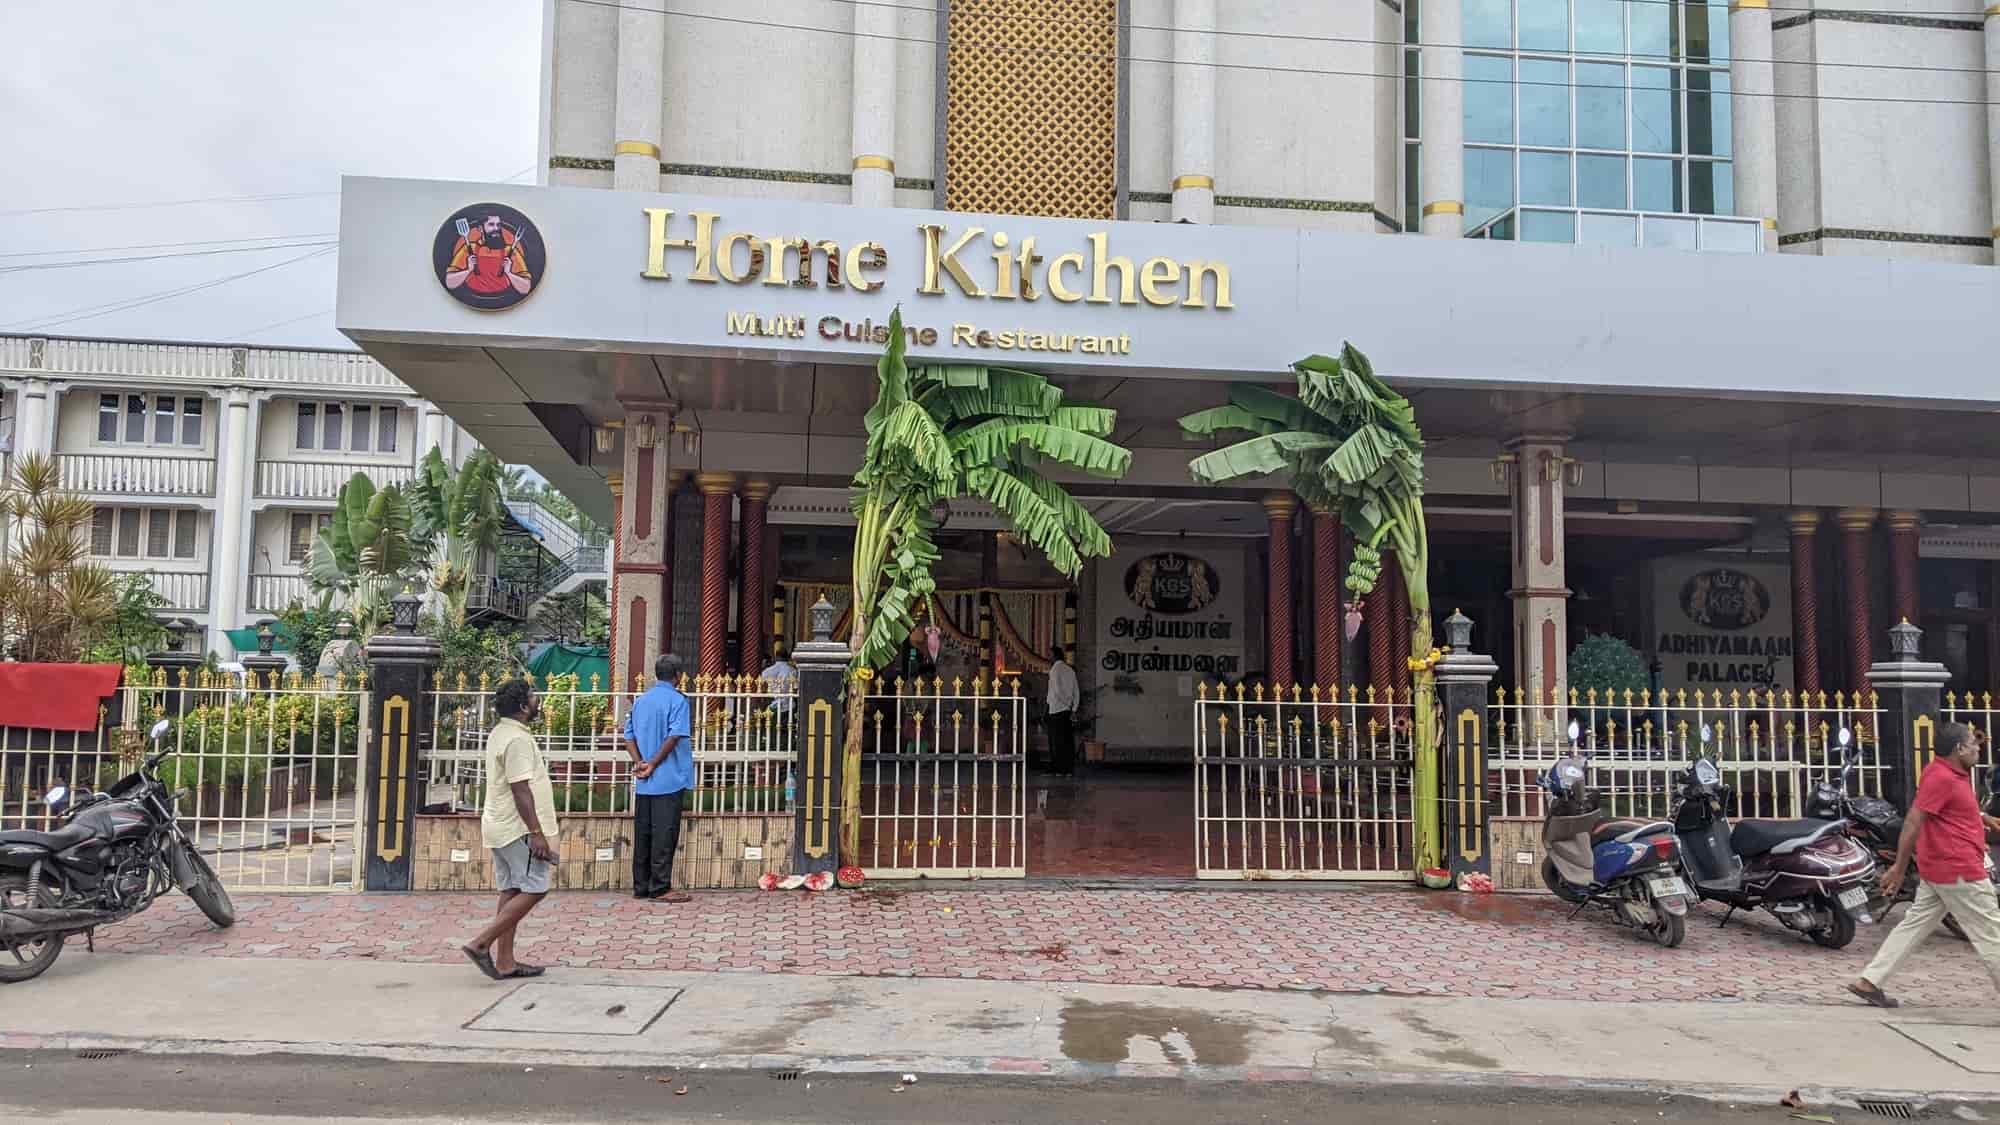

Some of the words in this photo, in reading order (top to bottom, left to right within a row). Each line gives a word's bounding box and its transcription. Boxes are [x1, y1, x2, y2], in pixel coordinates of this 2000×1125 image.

[640, 207, 888, 292] Home
[915, 223, 1235, 308] Kitchen
[726, 310, 806, 338] Multi
[817, 315, 938, 346] Cuisne
[952, 322, 1131, 354] Restaurant
[1110, 612, 1232, 642] அதியமான்
[1102, 645, 1241, 673] அரண்மனை
[1658, 633, 1791, 657] ADHIYAMAAN
